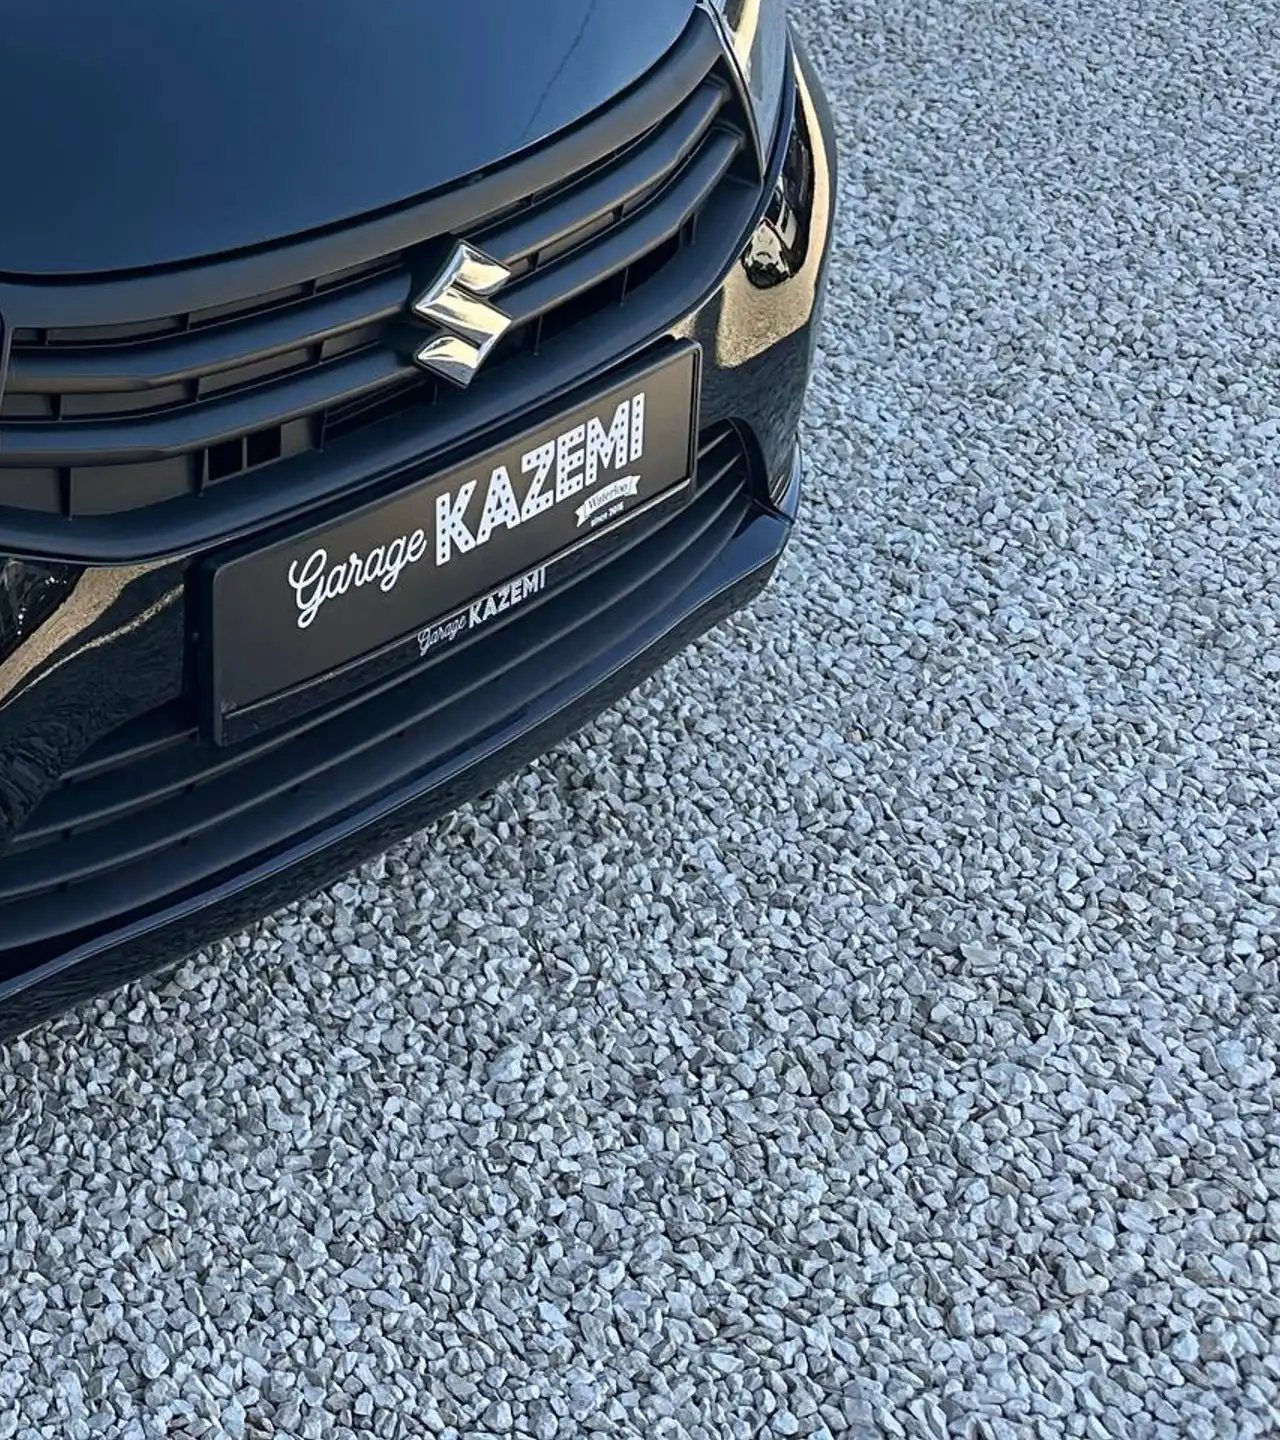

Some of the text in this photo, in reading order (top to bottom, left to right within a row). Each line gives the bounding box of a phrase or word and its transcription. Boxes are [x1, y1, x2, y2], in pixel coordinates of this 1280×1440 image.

[289, 392, 645, 628] Garage KAZEMI
[588, 482, 629, 509] Waterloo
[417, 566, 546, 657] Garage KAZEMI
